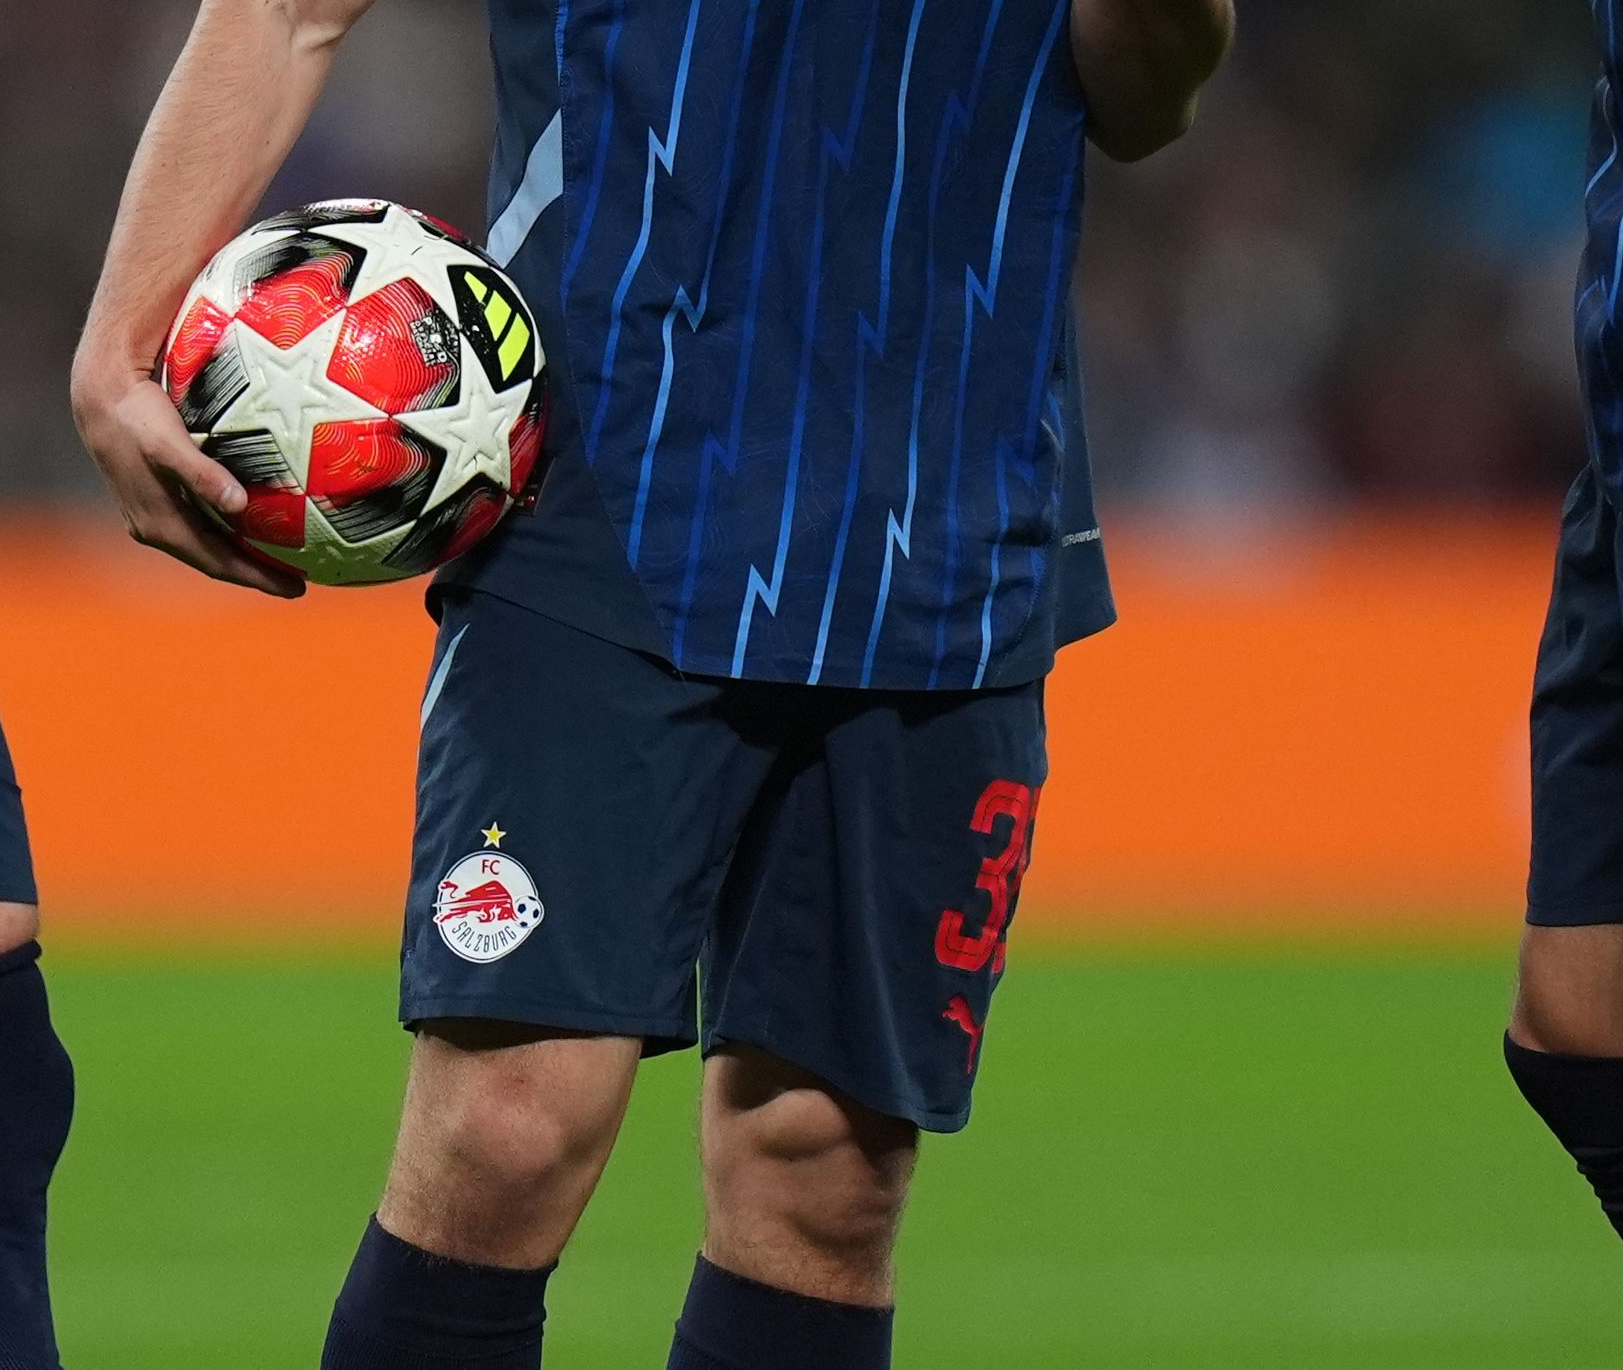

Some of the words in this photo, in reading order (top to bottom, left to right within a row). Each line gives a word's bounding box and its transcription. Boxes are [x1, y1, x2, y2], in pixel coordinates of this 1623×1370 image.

[481, 858, 501, 876] FC
[935, 778, 1042, 974] 3
[451, 920, 517, 953] SALZBURG
